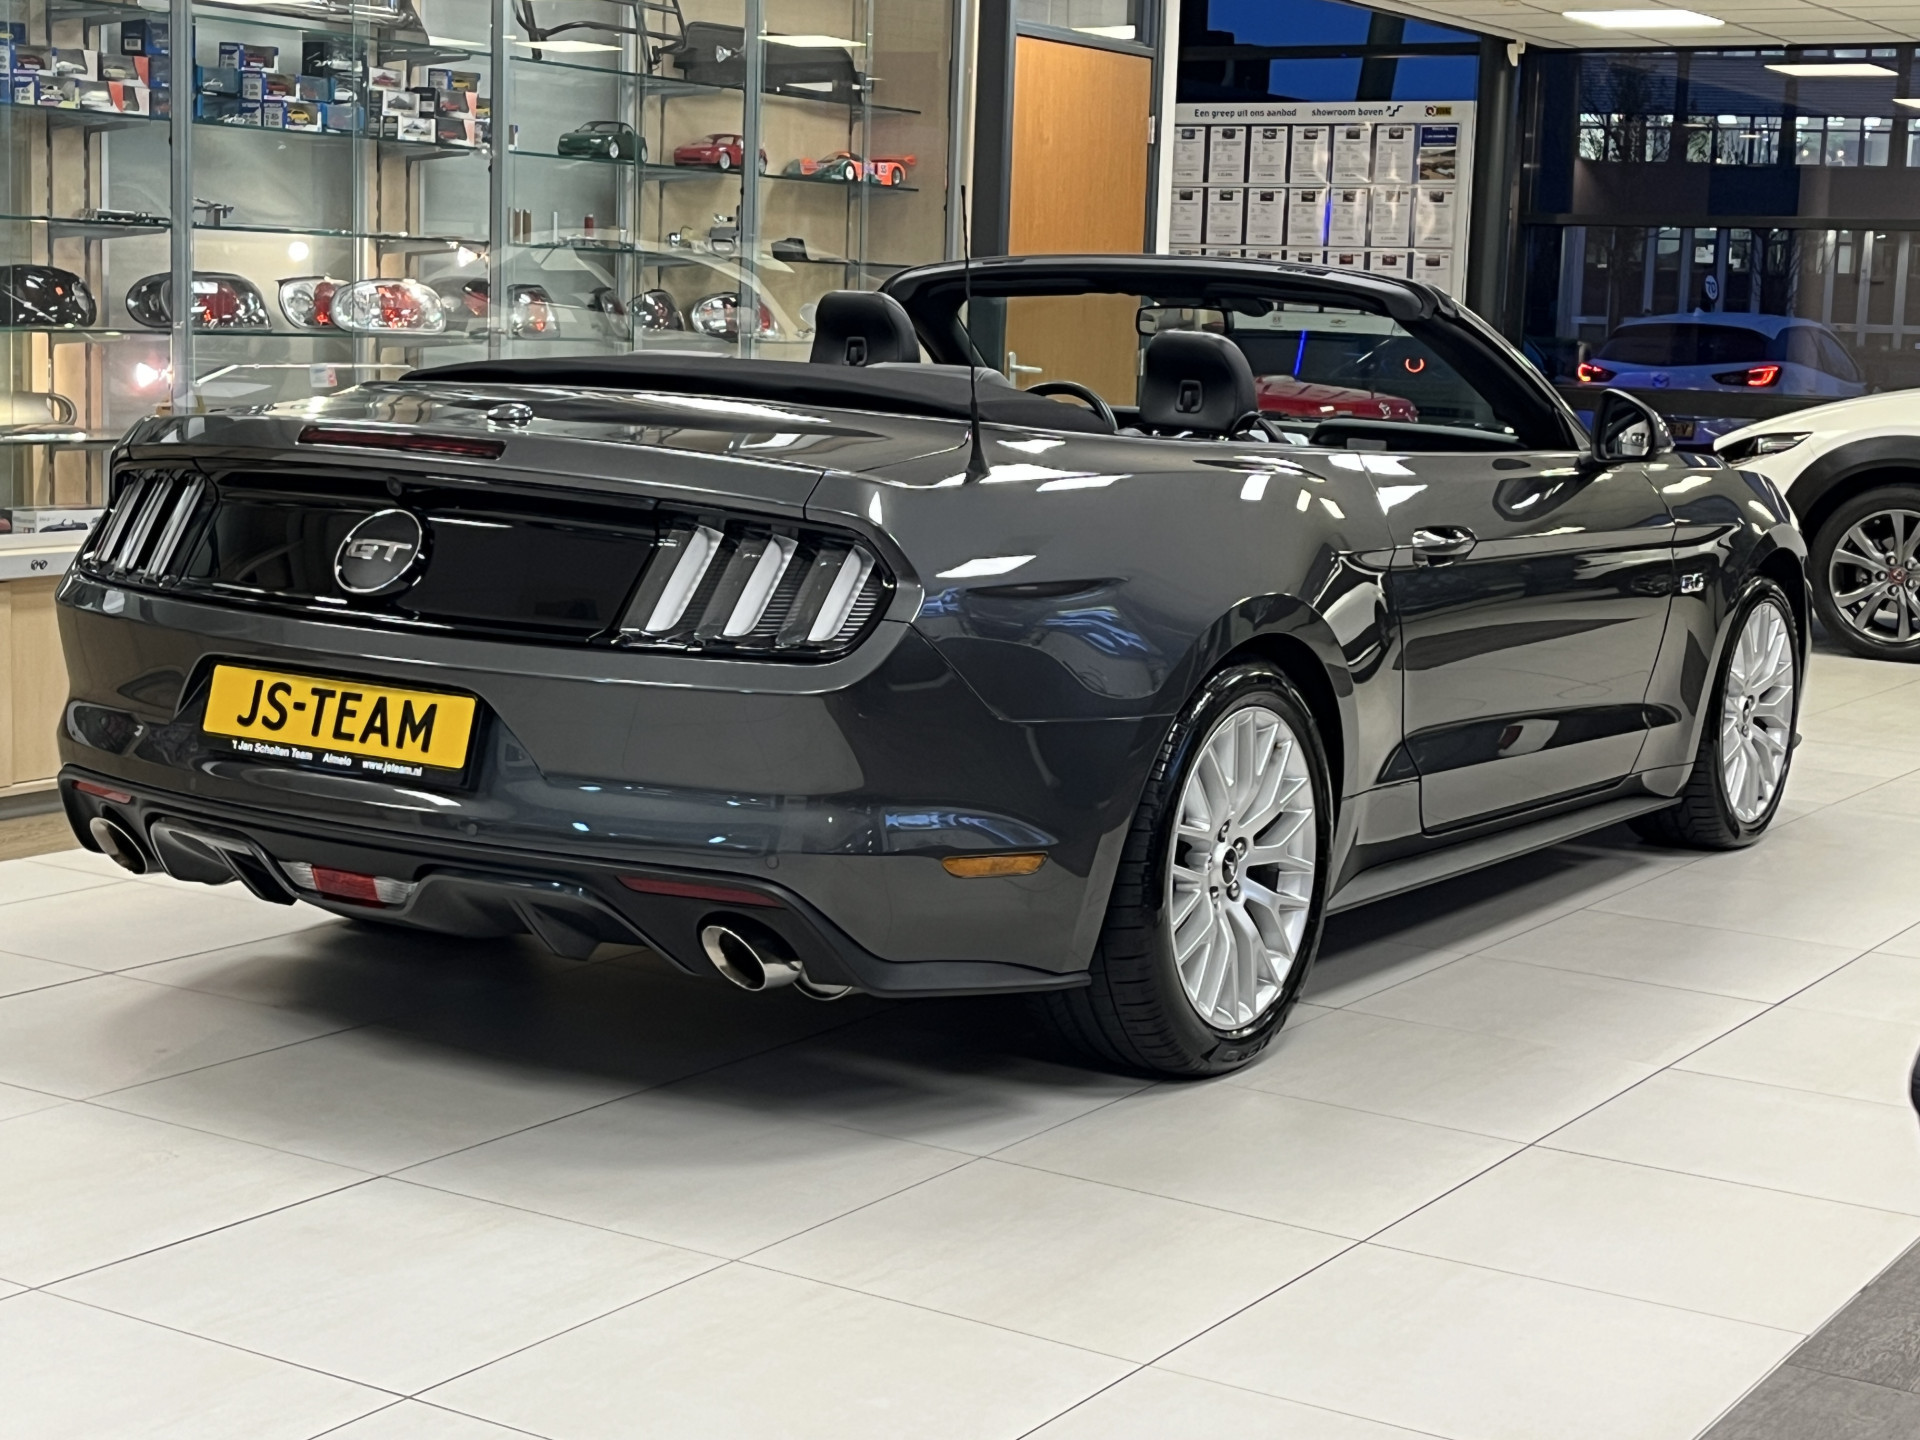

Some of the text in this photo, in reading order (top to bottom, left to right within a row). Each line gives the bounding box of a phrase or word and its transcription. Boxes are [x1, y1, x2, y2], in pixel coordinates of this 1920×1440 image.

[1194, 108, 1297, 119] Een greep uit ons aanbod
[1311, 107, 1383, 117] showroom boven
[346, 538, 412, 562] GT
[237, 679, 438, 753] JS-TEAM
[238, 740, 253, 751] Jan
[254, 742, 289, 757] Scholten
[291, 747, 313, 760] Team
[322, 752, 352, 766] Almelo
[362, 760, 422, 777] www.jsteam.nl
